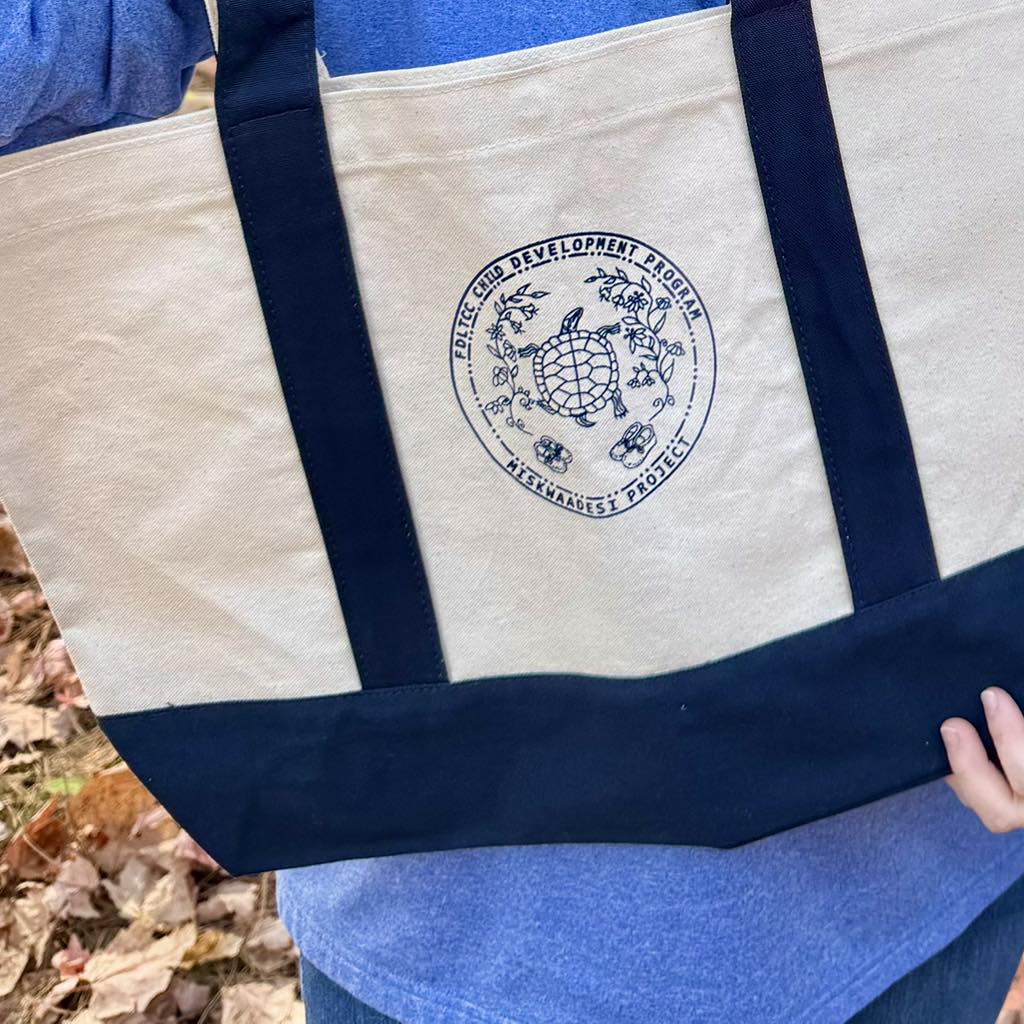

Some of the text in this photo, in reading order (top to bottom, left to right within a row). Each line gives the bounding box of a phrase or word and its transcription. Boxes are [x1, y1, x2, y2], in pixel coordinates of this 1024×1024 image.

[454, 237, 703, 360] FDLTCC CHILD DEVELOPMENT PROGRAM
[505, 435, 691, 515] MISKWAADESI PROJECT
